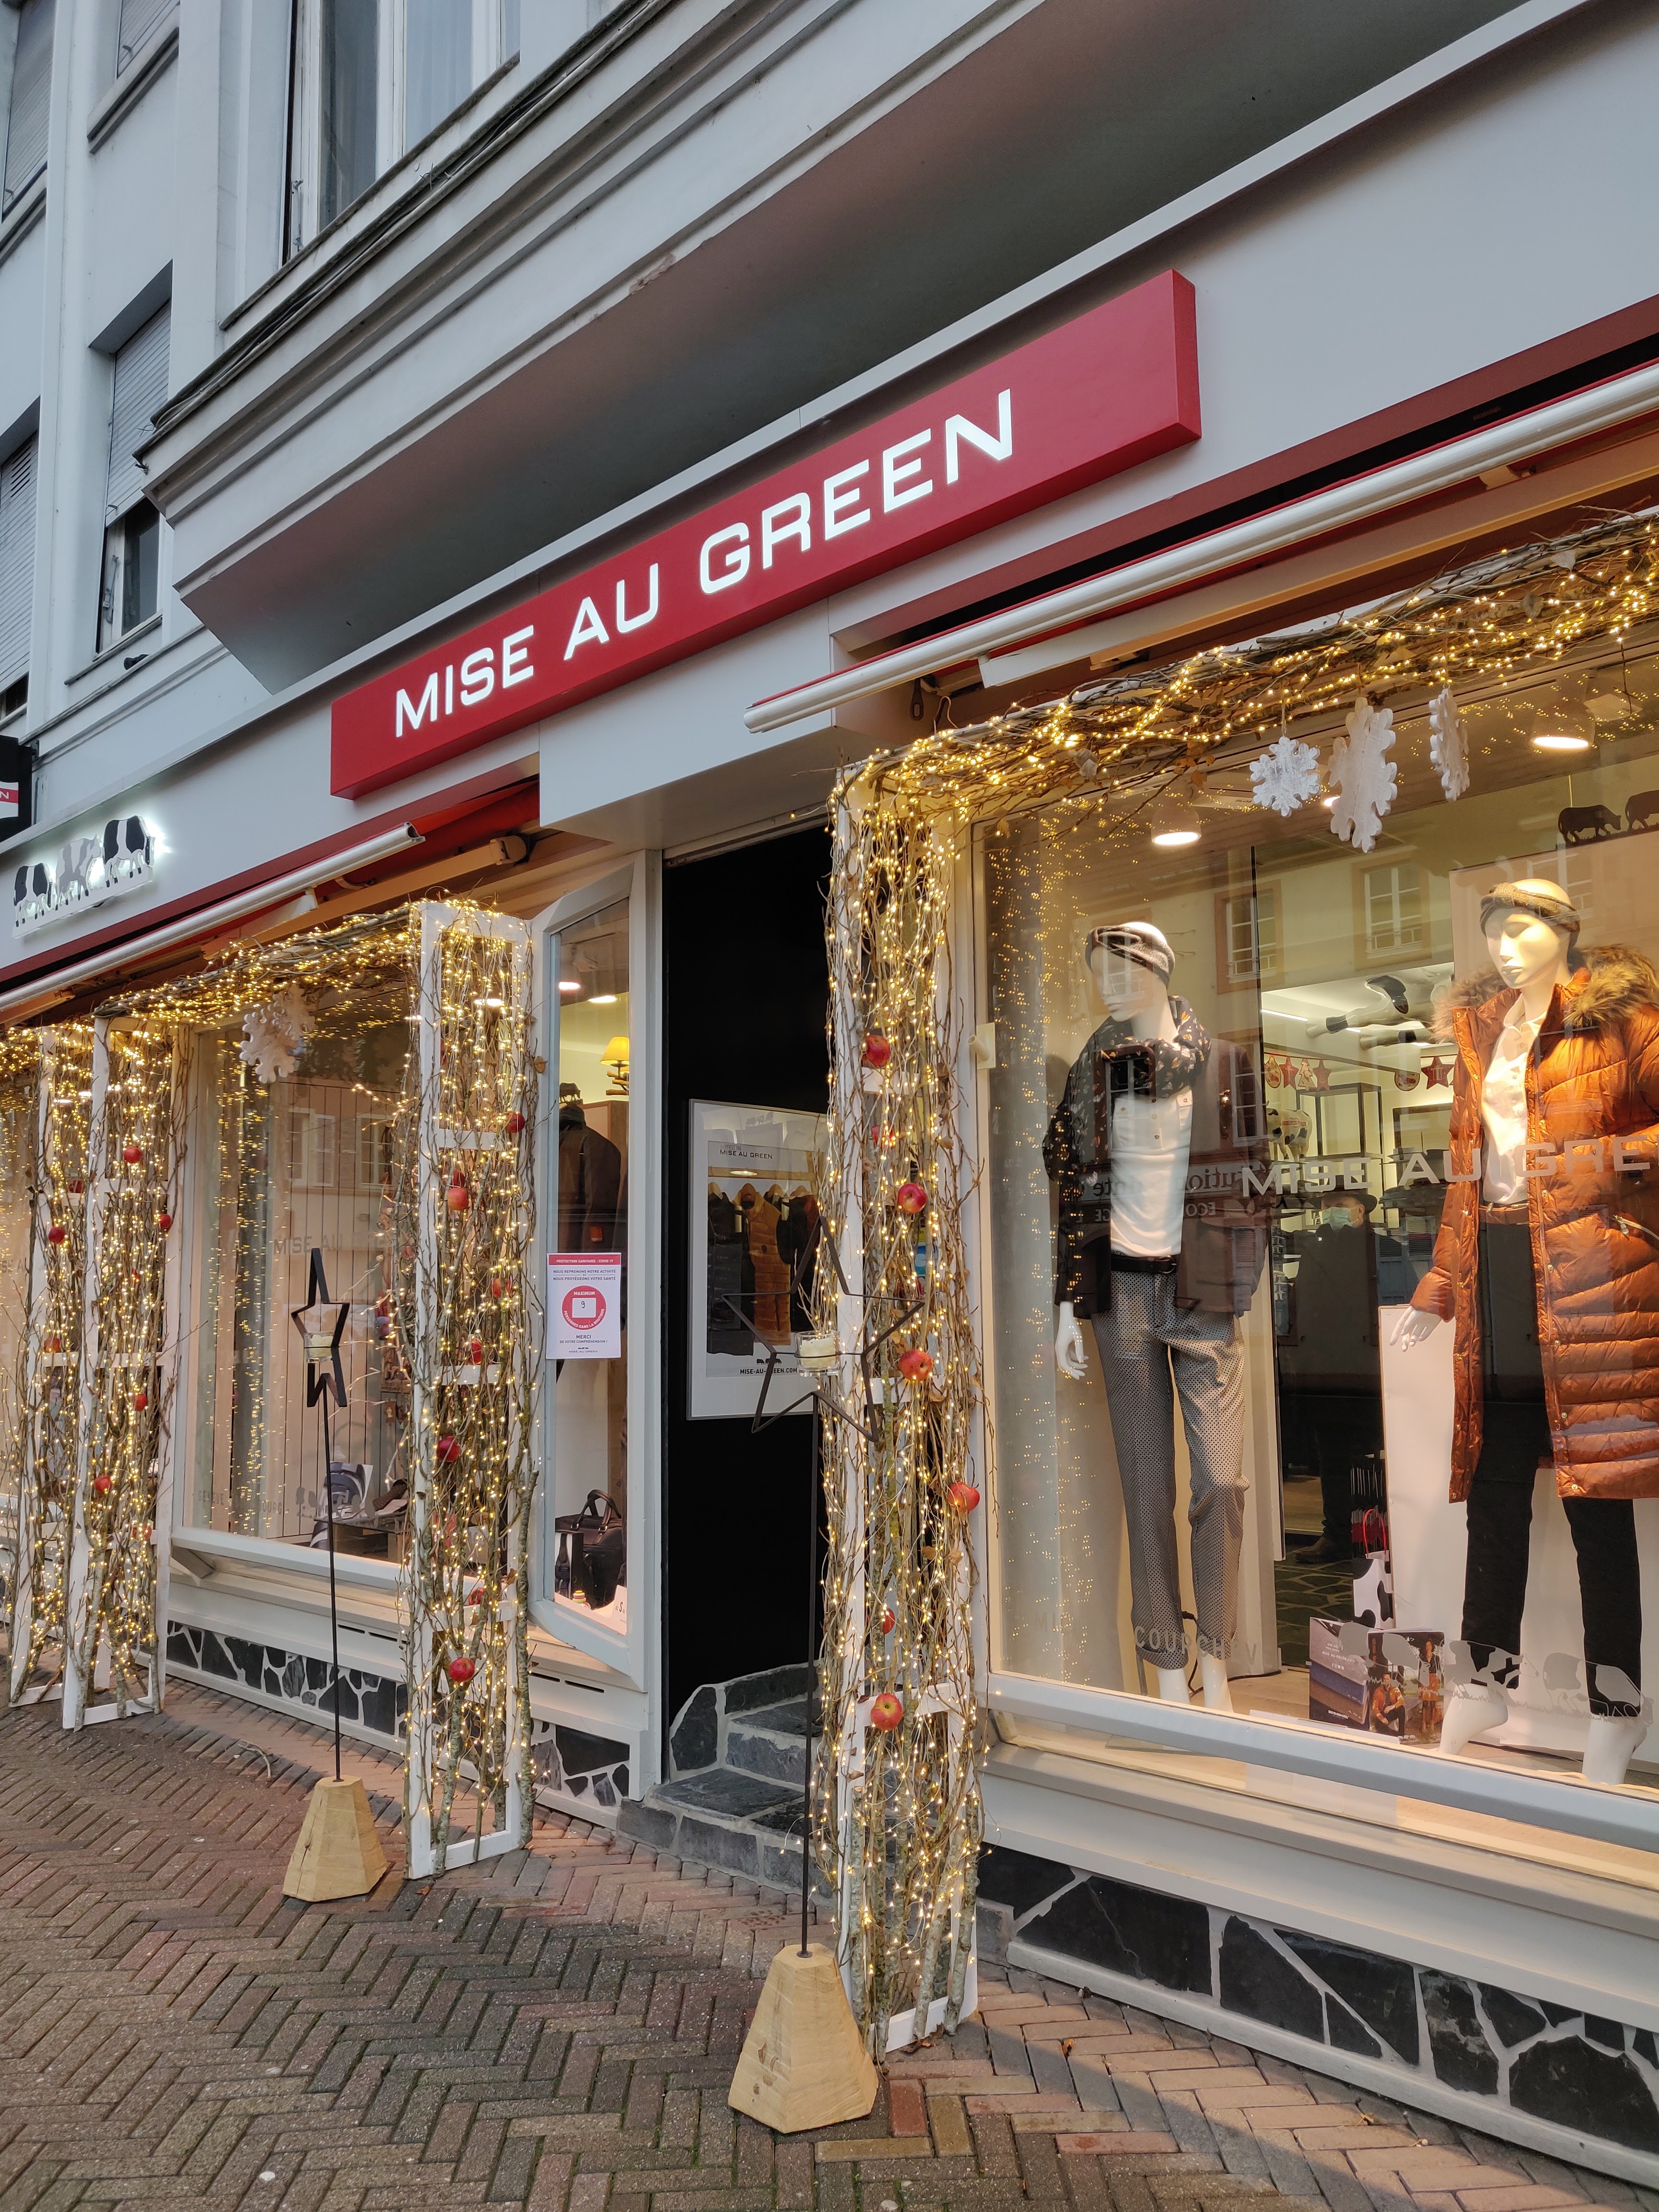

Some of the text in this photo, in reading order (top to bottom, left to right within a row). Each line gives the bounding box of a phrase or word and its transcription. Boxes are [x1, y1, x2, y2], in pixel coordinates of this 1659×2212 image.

[396, 388, 1012, 737] MISE AU GREEN
[1242, 1135, 1659, 1197] MISE AU GRE
[564, 1310, 578, 1328] PERSONNES
[593, 1309, 605, 1325] BOUTIQUE
[581, 1300, 586, 1309] 9
